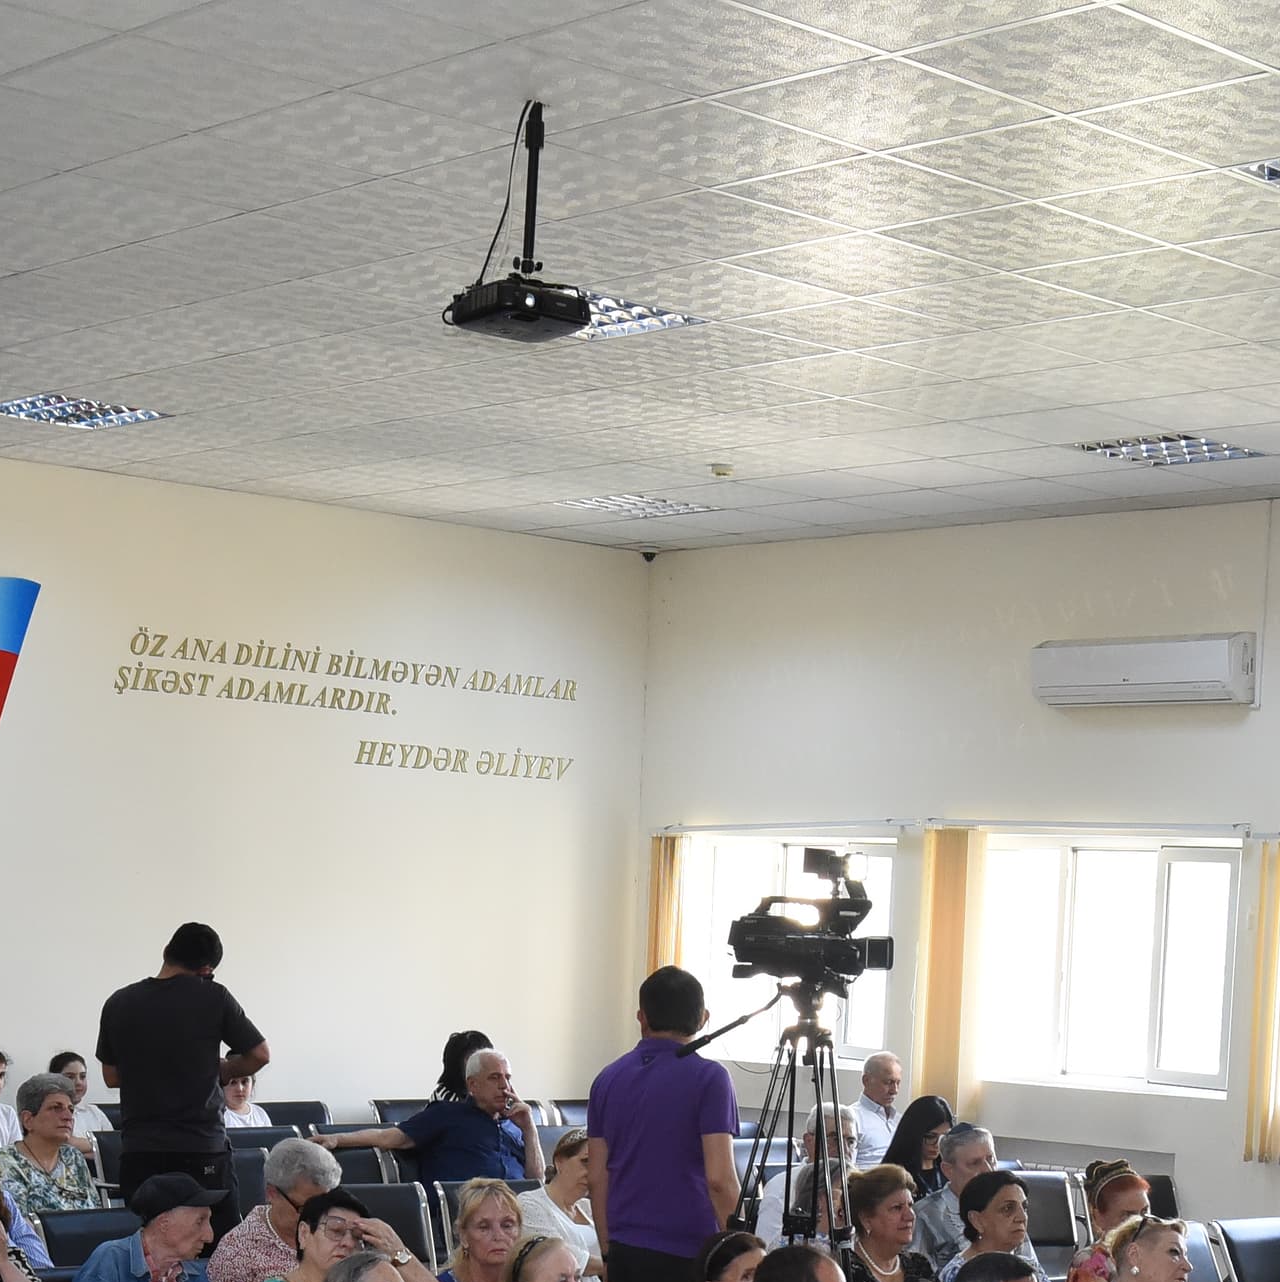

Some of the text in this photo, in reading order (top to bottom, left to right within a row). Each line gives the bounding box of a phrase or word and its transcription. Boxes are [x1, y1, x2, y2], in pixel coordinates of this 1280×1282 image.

[114, 661, 398, 716] ŞİKƏST ADAMLARDIR.
[130, 626, 577, 701] ÖZ ANA DİLİNİ BİLMƏYƏN ADAMLAR
[354, 740, 575, 781] HEYDƏR ƏLİYEV
